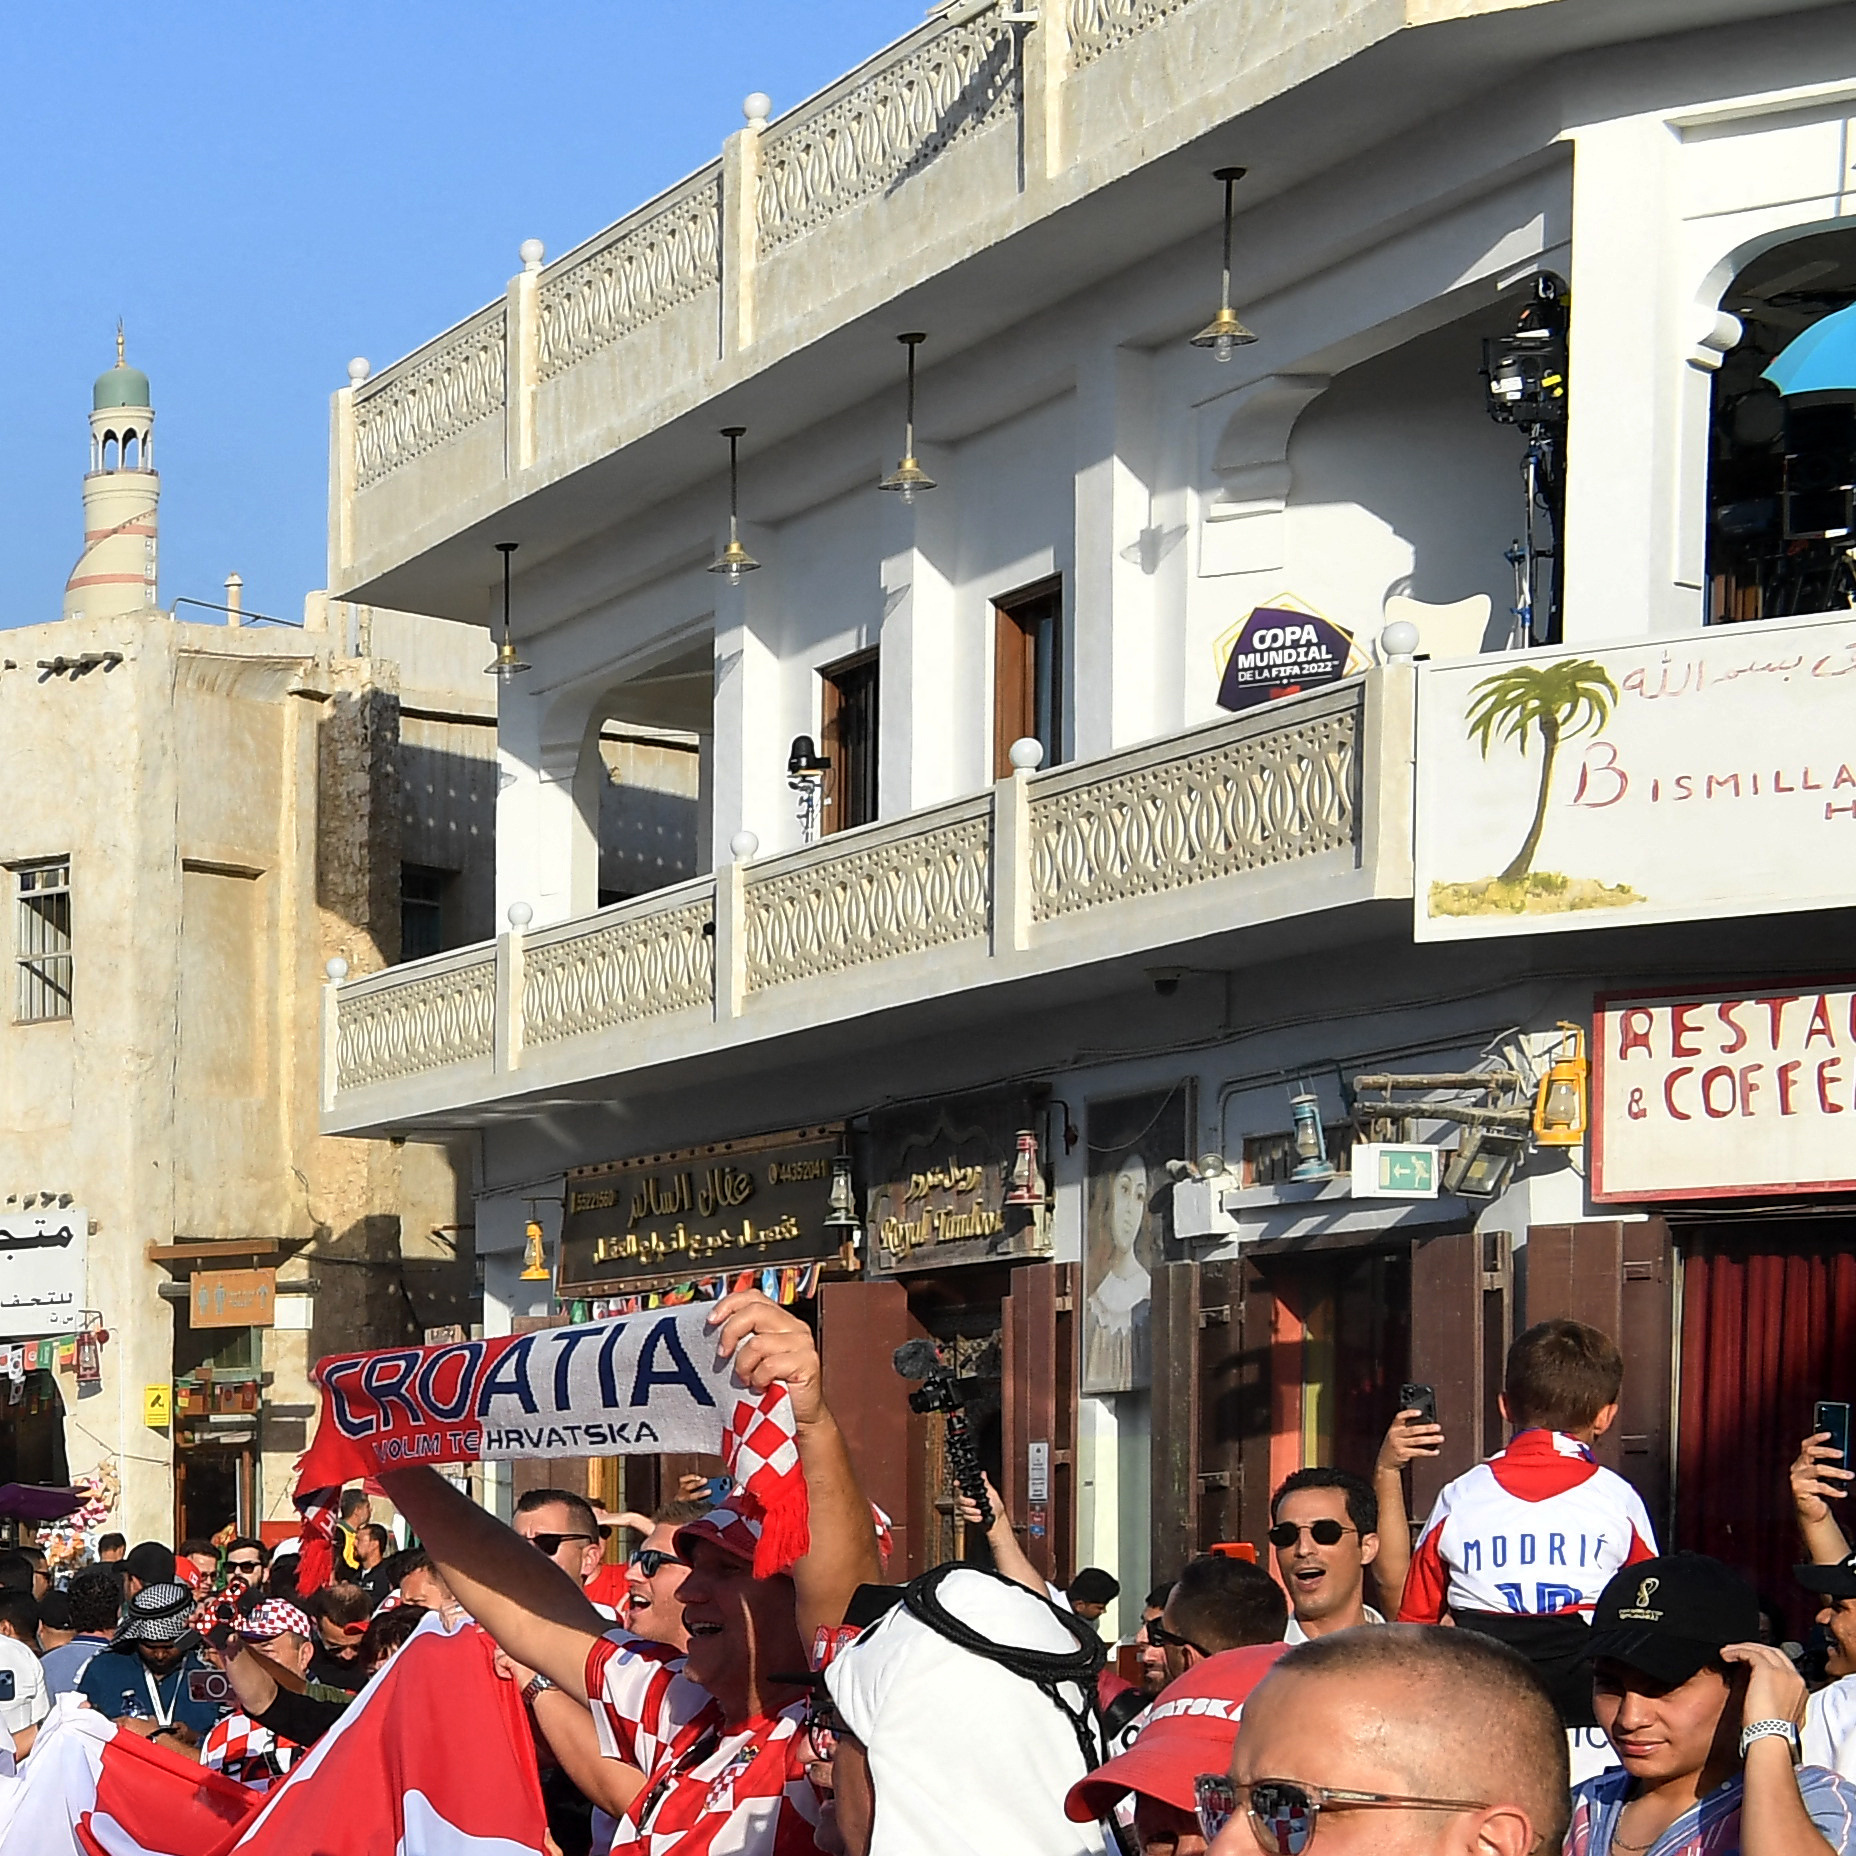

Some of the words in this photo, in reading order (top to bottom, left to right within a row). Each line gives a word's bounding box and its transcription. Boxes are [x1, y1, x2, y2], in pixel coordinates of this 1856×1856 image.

[1238, 645, 1333, 669] MUNDIAL
[1252, 624, 1319, 650] COPA
[1238, 670, 1254, 682] DE
[1255, 669, 1270, 680] LA
[1271, 664, 1301, 678] FIFA
[1622, 650, 1705, 699] الله
[1619, 993, 1856, 1061] RESTA
[1664, 1056, 1856, 1121] COFFE
[0, 1292, 73, 1308] للتحف
[323, 1316, 716, 1439] CROATIA
[373, 1432, 440, 1463] VOLIM
[448, 1430, 480, 1454] TE
[487, 1420, 659, 1451] HRVATSKA
[1463, 1533, 1607, 1574] MODRIĆ
